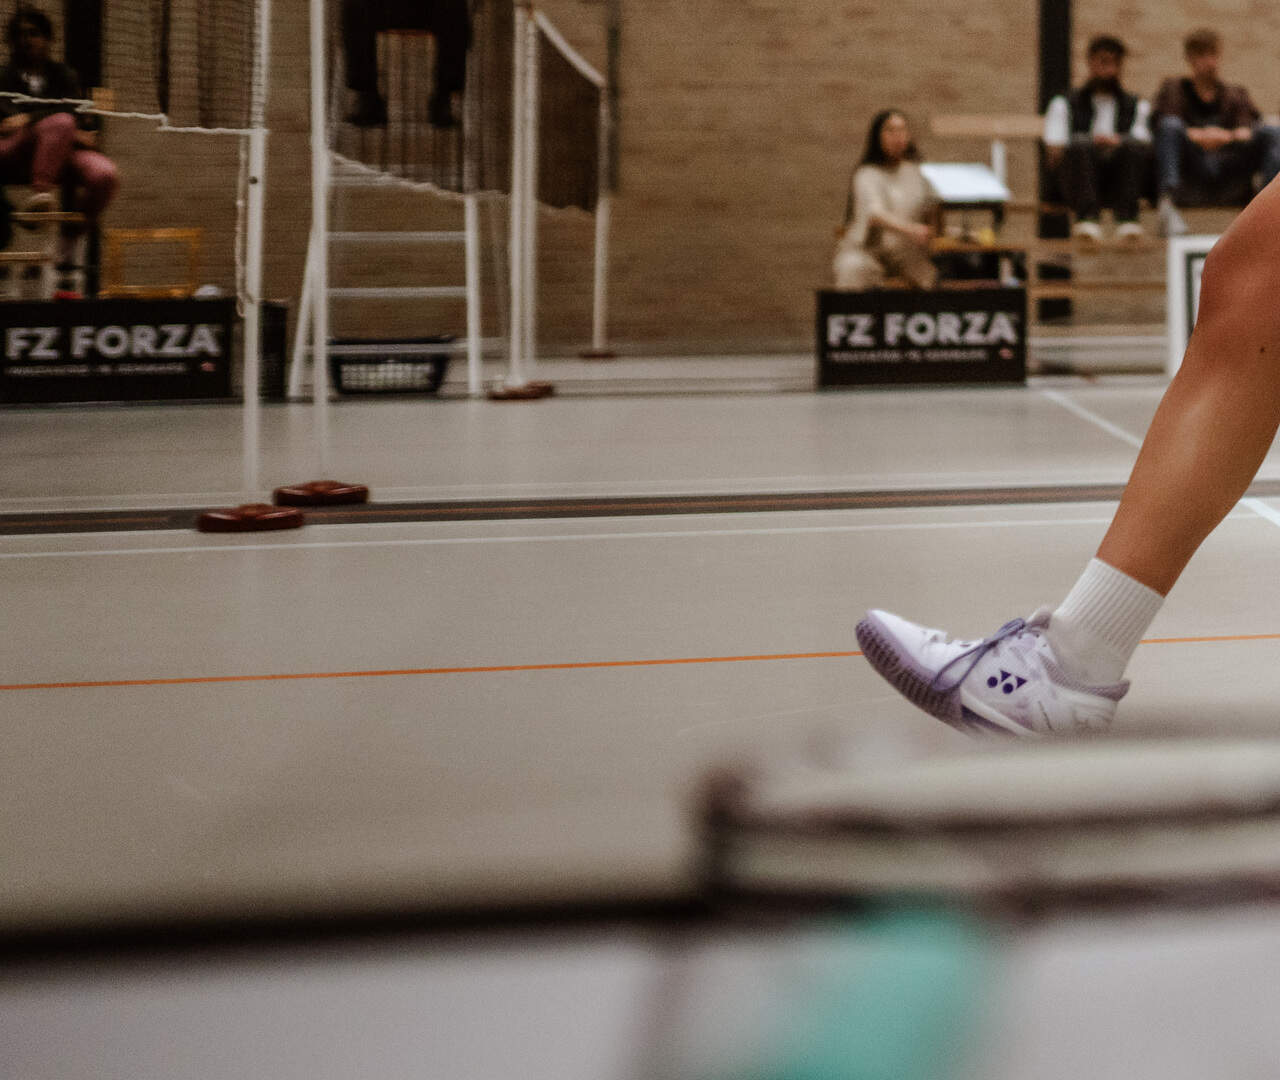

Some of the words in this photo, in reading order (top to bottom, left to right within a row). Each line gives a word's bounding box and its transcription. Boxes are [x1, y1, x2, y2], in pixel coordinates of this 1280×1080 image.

[4, 326, 60, 360] FZ
[69, 324, 220, 359] FORZA
[826, 314, 874, 347] FZ
[884, 312, 1018, 346] FORZA
